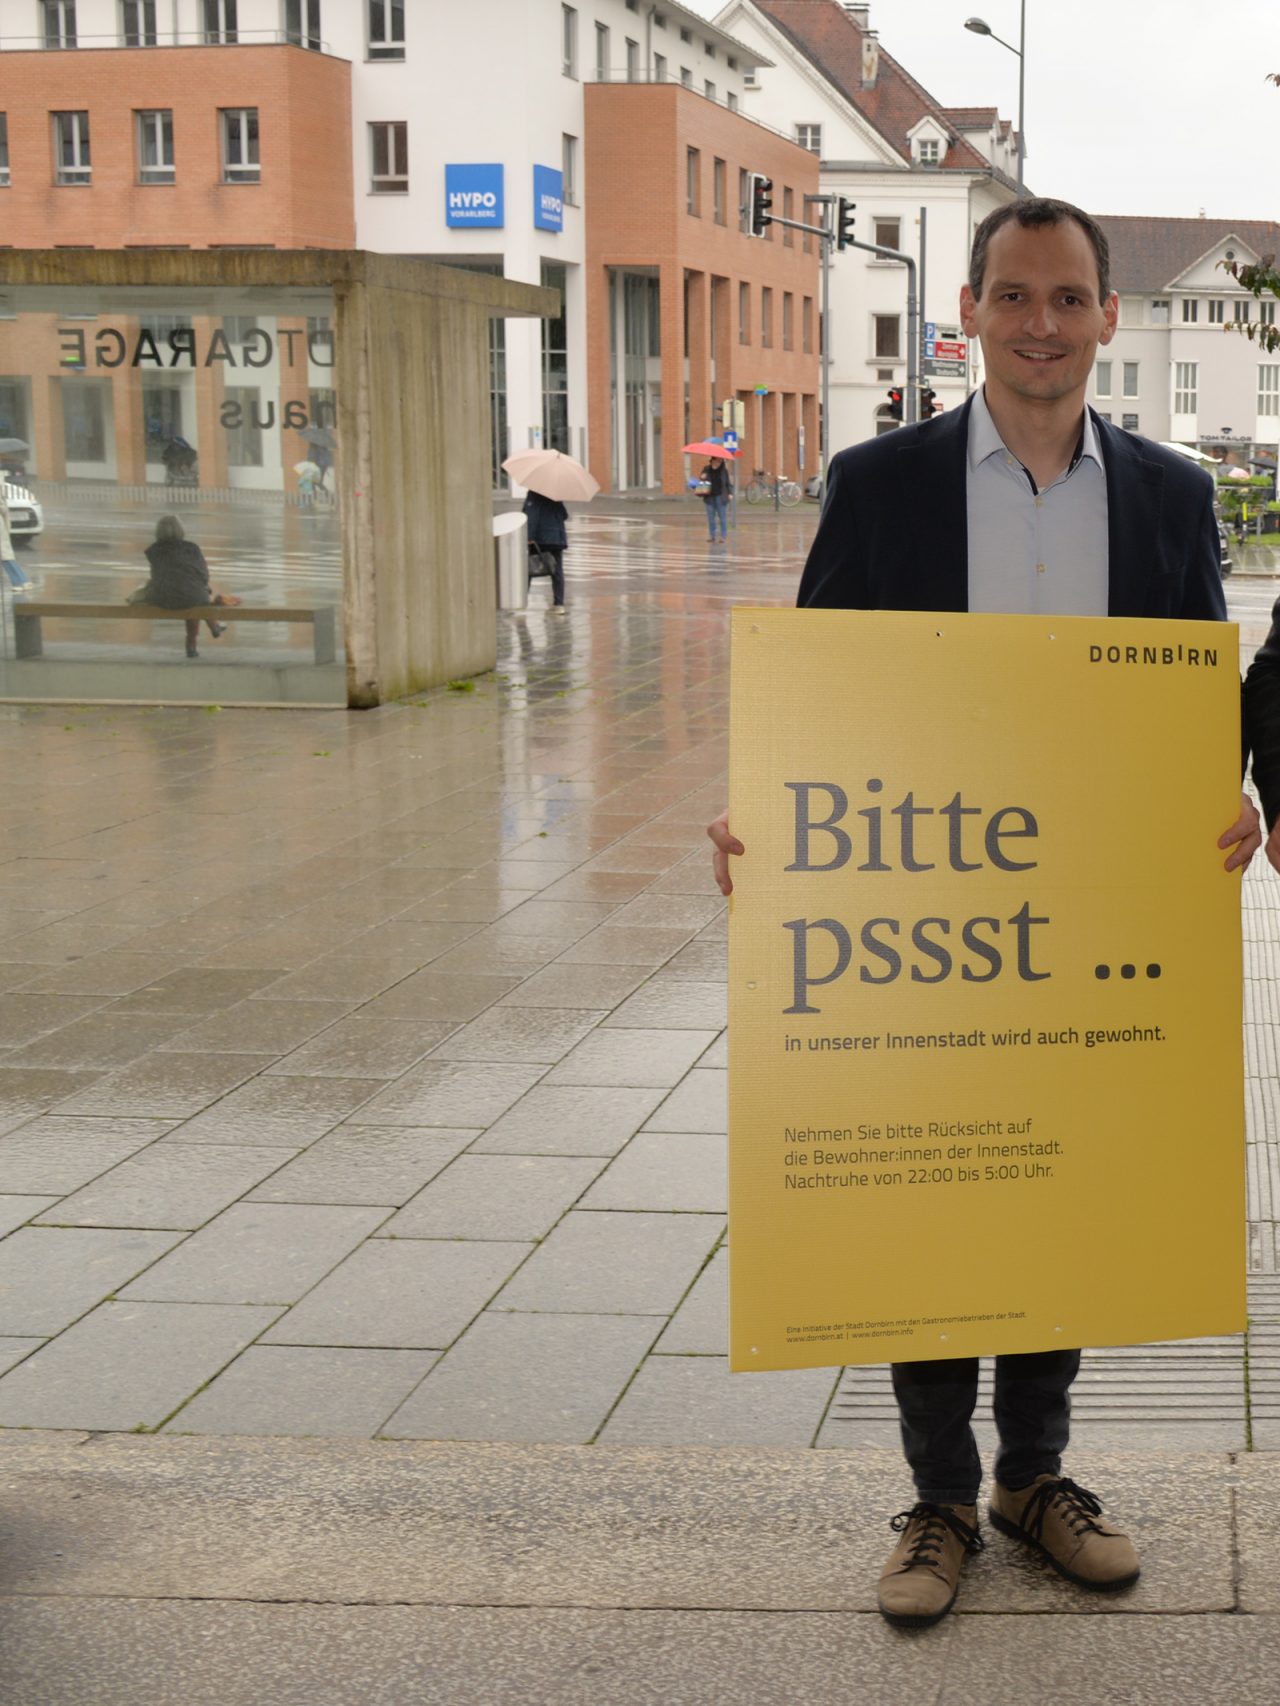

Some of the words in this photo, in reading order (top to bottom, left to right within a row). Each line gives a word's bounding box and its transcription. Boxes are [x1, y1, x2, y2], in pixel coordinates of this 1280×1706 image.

[450, 192, 496, 208] HYPO
[1090, 645, 1217, 666] DORNBIRN
[784, 779, 1039, 872] Bitte
[783, 901, 1052, 1014] pssst
[786, 1035, 801, 1051] in
[809, 1037, 880, 1050] unserer
[887, 1030, 986, 1048] Innenstadt
[992, 1028, 1030, 1045] wird
[1038, 1027, 1078, 1044] auch
[1085, 1025, 1165, 1047] gewohnt.
[785, 1127, 852, 1142] Nehmen
[858, 1125, 880, 1140] Sie
[887, 1124, 922, 1139] bitte
[929, 1120, 1002, 1136] Rücksicht
[1008, 1118, 1032, 1134] auf
[785, 1151, 807, 1166] die
[814, 1147, 941, 1165] Bewohner:innen
[948, 1144, 972, 1159] der
[978, 1140, 1063, 1157] Innenstadt.
[785, 1172, 868, 1189] Nachtruhe
[873, 1173, 902, 1185] von
[908, 1168, 952, 1183] 22:00
[959, 1167, 979, 1181] bis
[985, 1165, 1019, 1180] 5:00
[1025, 1163, 1053, 1178] Uhr.
[787, 1333, 843, 1343] www.dornbirn.at
[853, 1328, 913, 1339] www.dornbirn.info
[802, 1324, 831, 1333] Initiative
[845, 1322, 863, 1330] Stadt
[866, 1320, 894, 1329] Dornbirn
[922, 1314, 994, 1325] Gastronomiebetrieben
